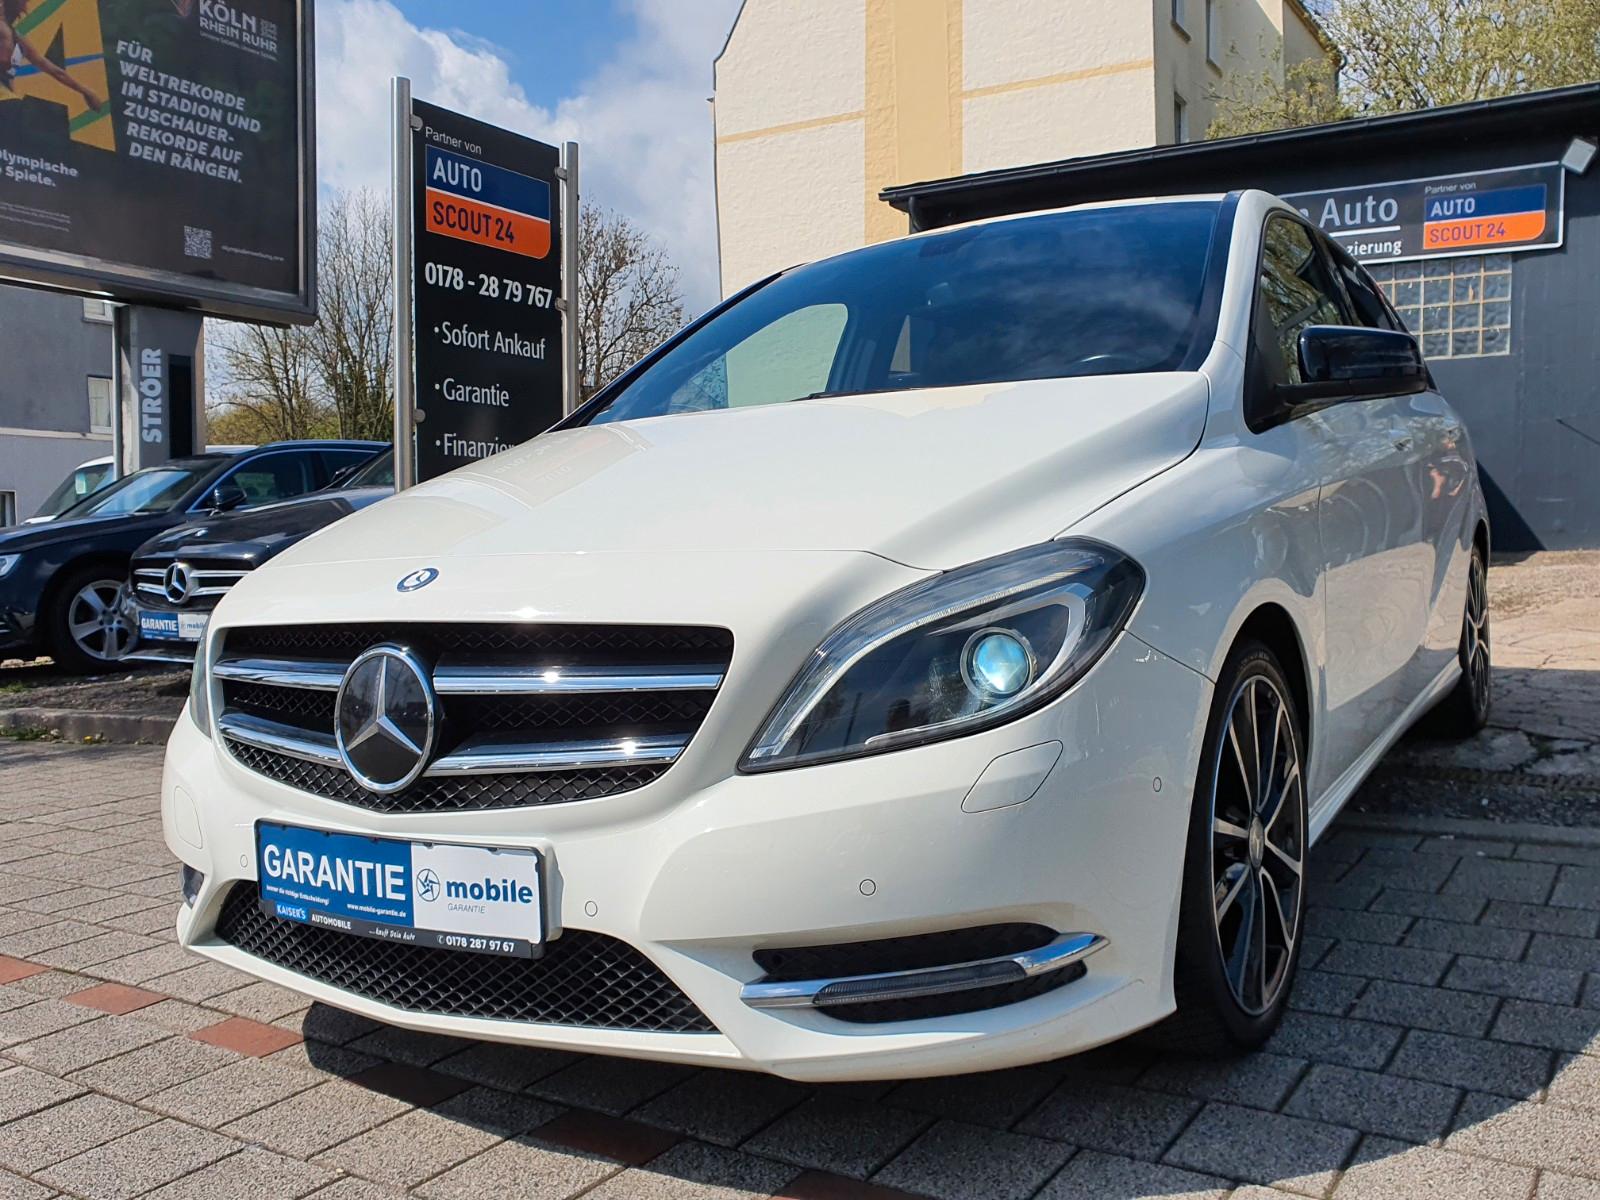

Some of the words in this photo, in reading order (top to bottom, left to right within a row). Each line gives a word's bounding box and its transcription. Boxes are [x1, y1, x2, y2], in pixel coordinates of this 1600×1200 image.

[199, 0, 257, 33] KÖLN
[199, 16, 240, 39] RHEIN
[242, 31, 278, 53] RUHR
[116, 40, 153, 63] FÜR
[119, 60, 246, 111] WELTREKORDE
[121, 81, 144, 99] IM
[147, 88, 222, 122] STADION
[226, 113, 261, 133] UND
[123, 101, 235, 142] ZUSCHAUER-
[126, 121, 208, 156] REKORDE
[210, 145, 244, 164] AUF
[425, 126, 462, 148] Partner
[464, 141, 482, 154] von
[5, 165, 57, 187] Spiele.
[129, 142, 167, 164] DEN
[170, 152, 243, 183] RÄNGEN.
[432, 156, 482, 192] AUTO
[1424, 183, 1457, 194] Partner
[1460, 181, 1477, 191] von
[1319, 195, 1399, 228] Auto
[1430, 197, 1476, 217] AUTO
[1347, 240, 1403, 256] zierung
[424, 261, 464, 291] 0178
[478, 273, 500, 299] 28
[502, 278, 522, 303] 79
[525, 283, 553, 309] 767
[441, 320, 491, 351] Sofort
[493, 331, 546, 361] Ankauf
[140, 347, 162, 443] STRÖER
[442, 377, 511, 408] Garantie
[141, 617, 178, 632] GARANTIE
[263, 843, 407, 902] GARANTIE
[446, 877, 534, 904] mobile
[311, 913, 352, 931] AUTOMOBILE
[447, 902, 486, 915] GARANTIE
[445, 936, 468, 949] 0178
[469, 939, 487, 951] 287
[489, 941, 501, 952] 97
[502, 942, 515, 953] 67
